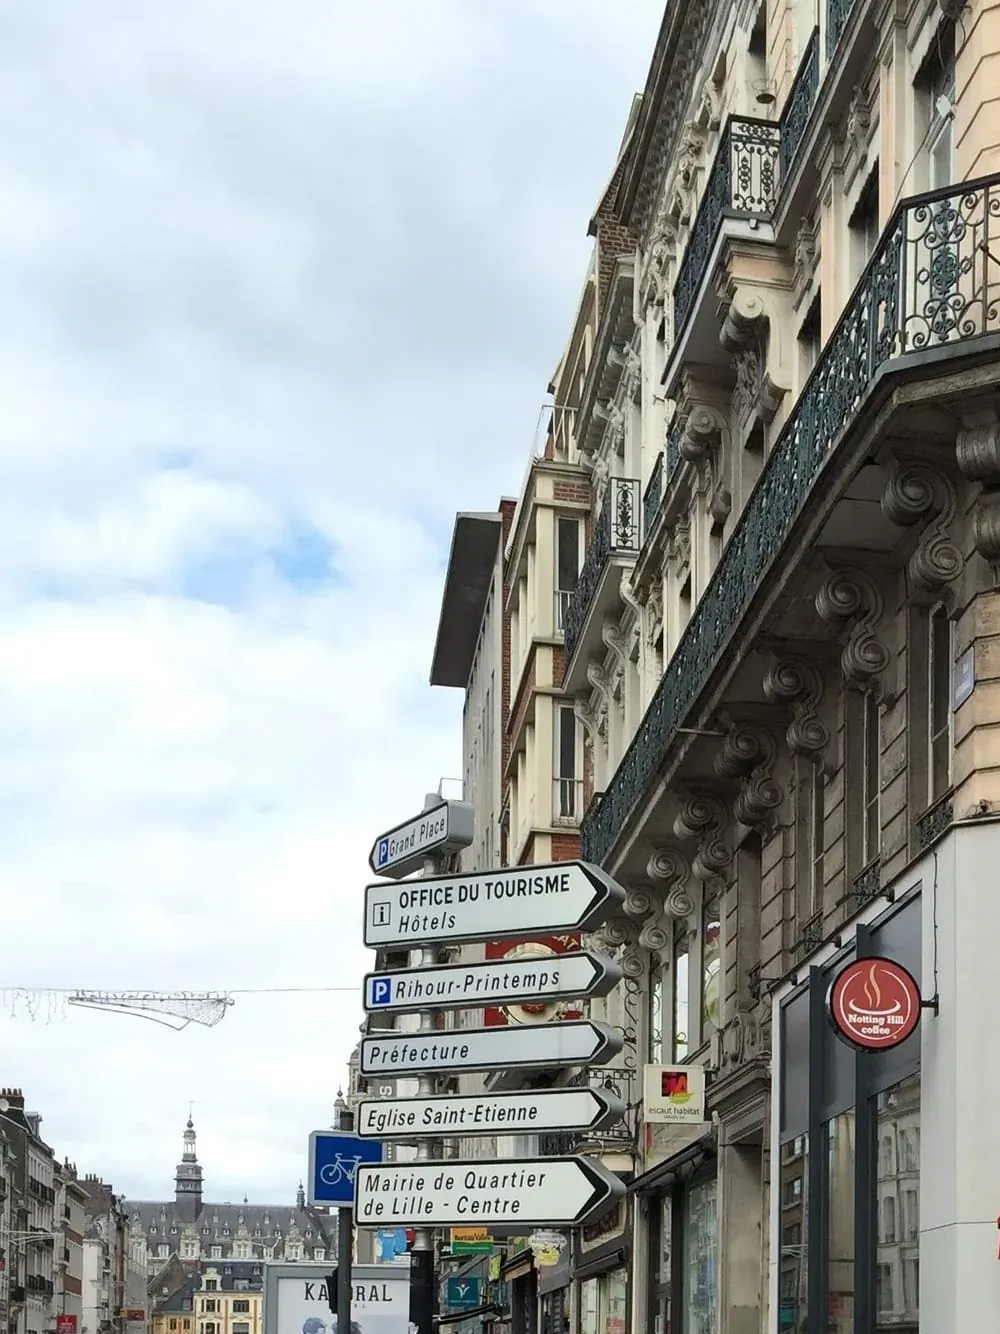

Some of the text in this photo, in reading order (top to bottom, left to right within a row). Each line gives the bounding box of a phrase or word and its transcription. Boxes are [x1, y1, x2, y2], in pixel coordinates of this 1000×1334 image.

[389, 828, 416, 857] Grand
[420, 818, 445, 842] Place
[399, 874, 571, 909] OFFICE DU TOURISME
[399, 911, 456, 933] Hôtels
[396, 970, 560, 999] Rihour-Printemps
[848, 1014, 904, 1026] Notting Hill
[861, 1025, 890, 1035] coffee
[370, 1044, 469, 1064] Préfecture
[367, 1103, 538, 1132] Eglise Saint-Etienne
[365, 1170, 546, 1192] Mairie de Quartier
[364, 1198, 384, 1216] de
[392, 1197, 434, 1215] Lille
[456, 1195, 521, 1214] Centre
[304, 1282, 392, 1302] KARAL
